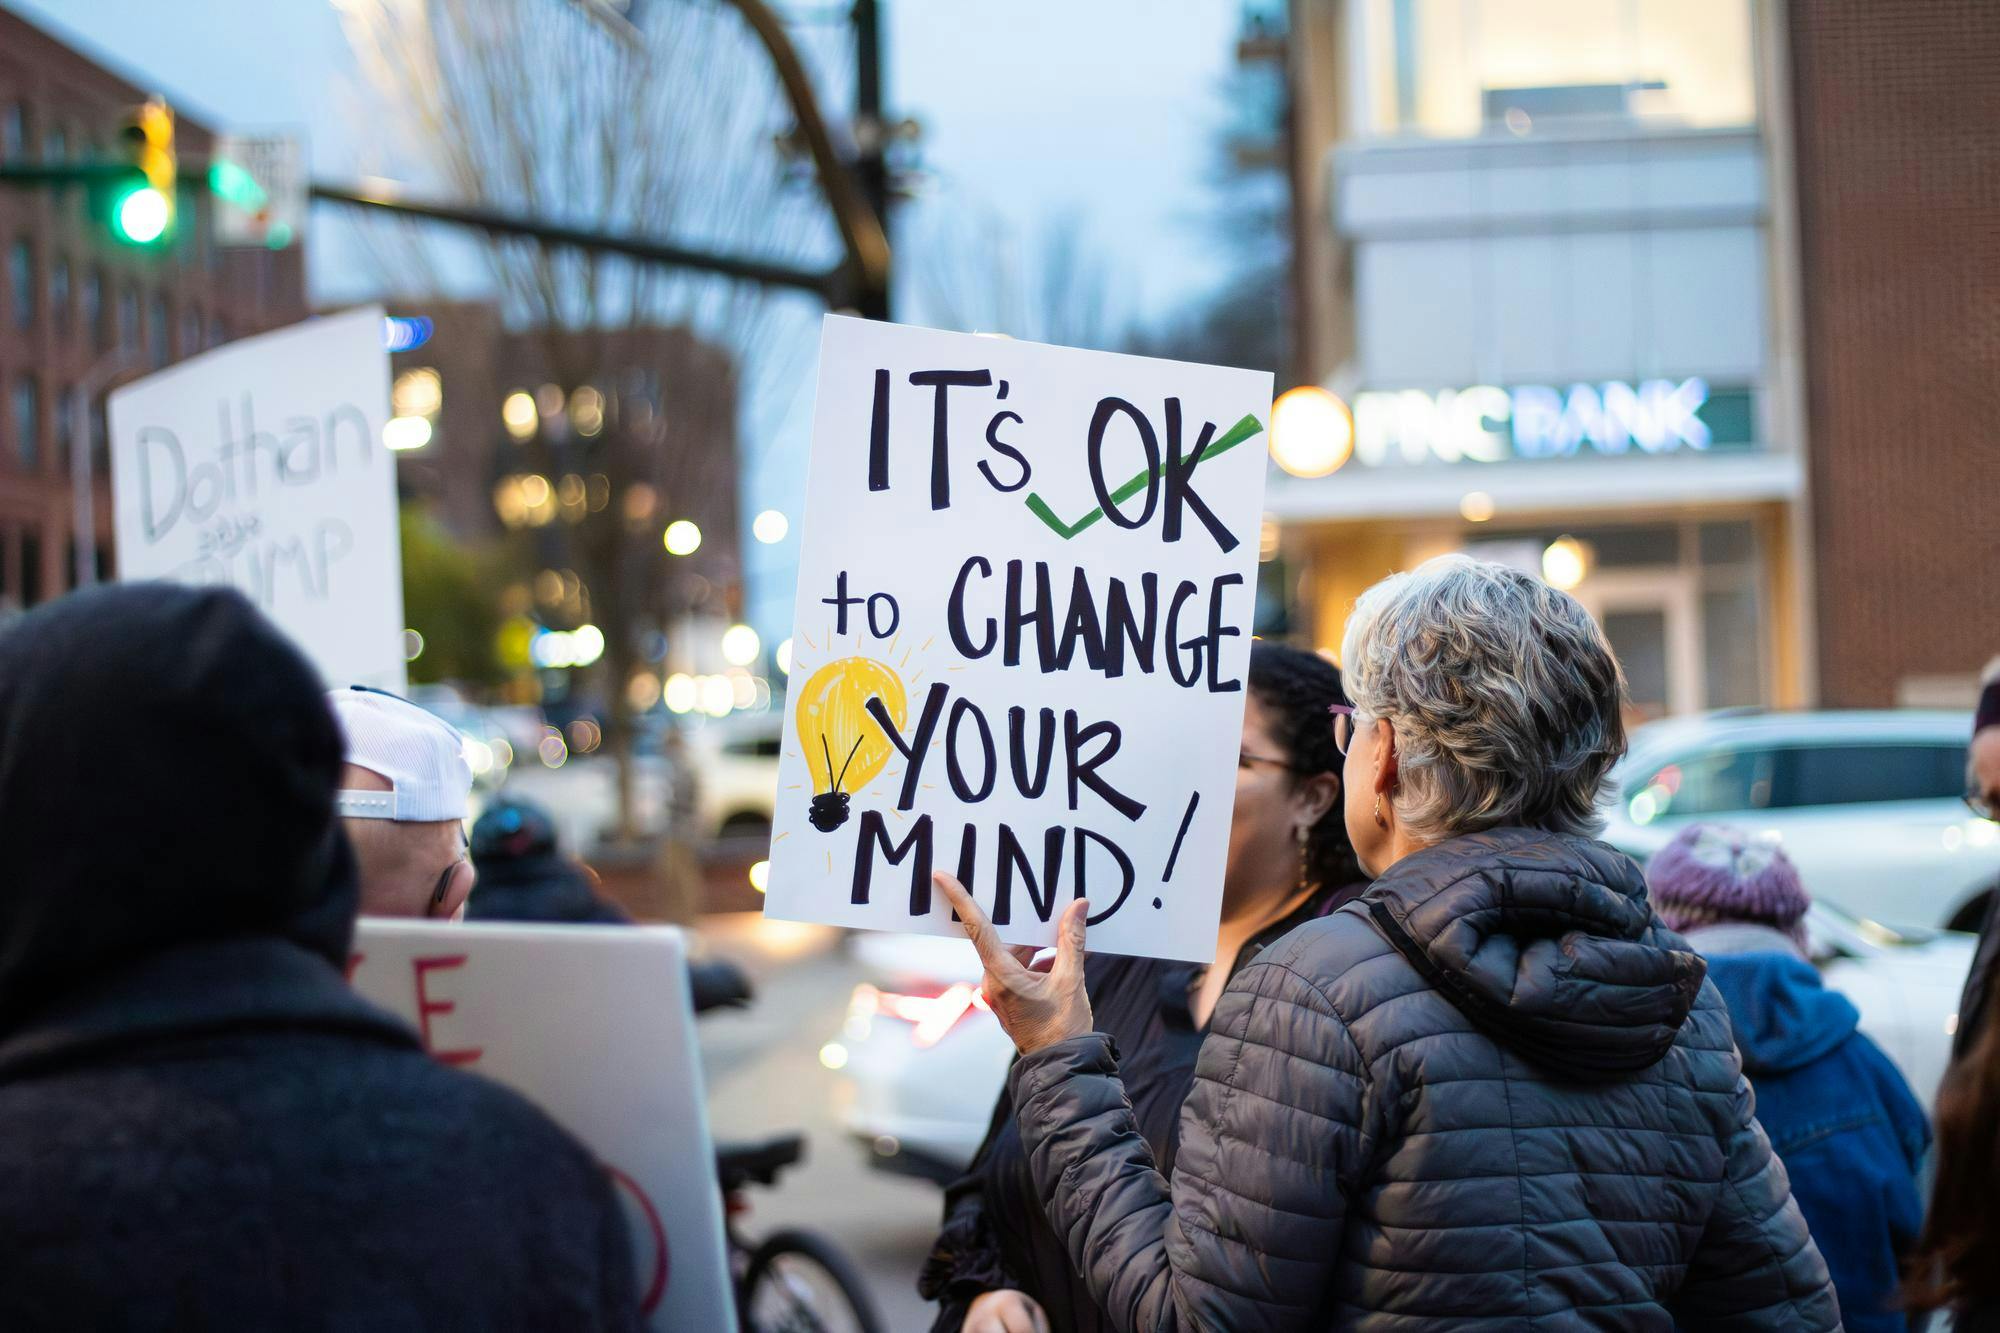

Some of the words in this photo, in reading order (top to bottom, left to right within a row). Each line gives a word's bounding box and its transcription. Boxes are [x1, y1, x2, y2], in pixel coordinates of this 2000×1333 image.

[136, 389, 373, 546] Dothan
[1087, 397, 1240, 554] OK
[1353, 385, 1512, 470] PNC
[1512, 377, 1711, 458] BANK
[822, 571, 900, 639] to
[946, 556, 1243, 693] CHANGE
[865, 682, 1147, 822] YOUR
